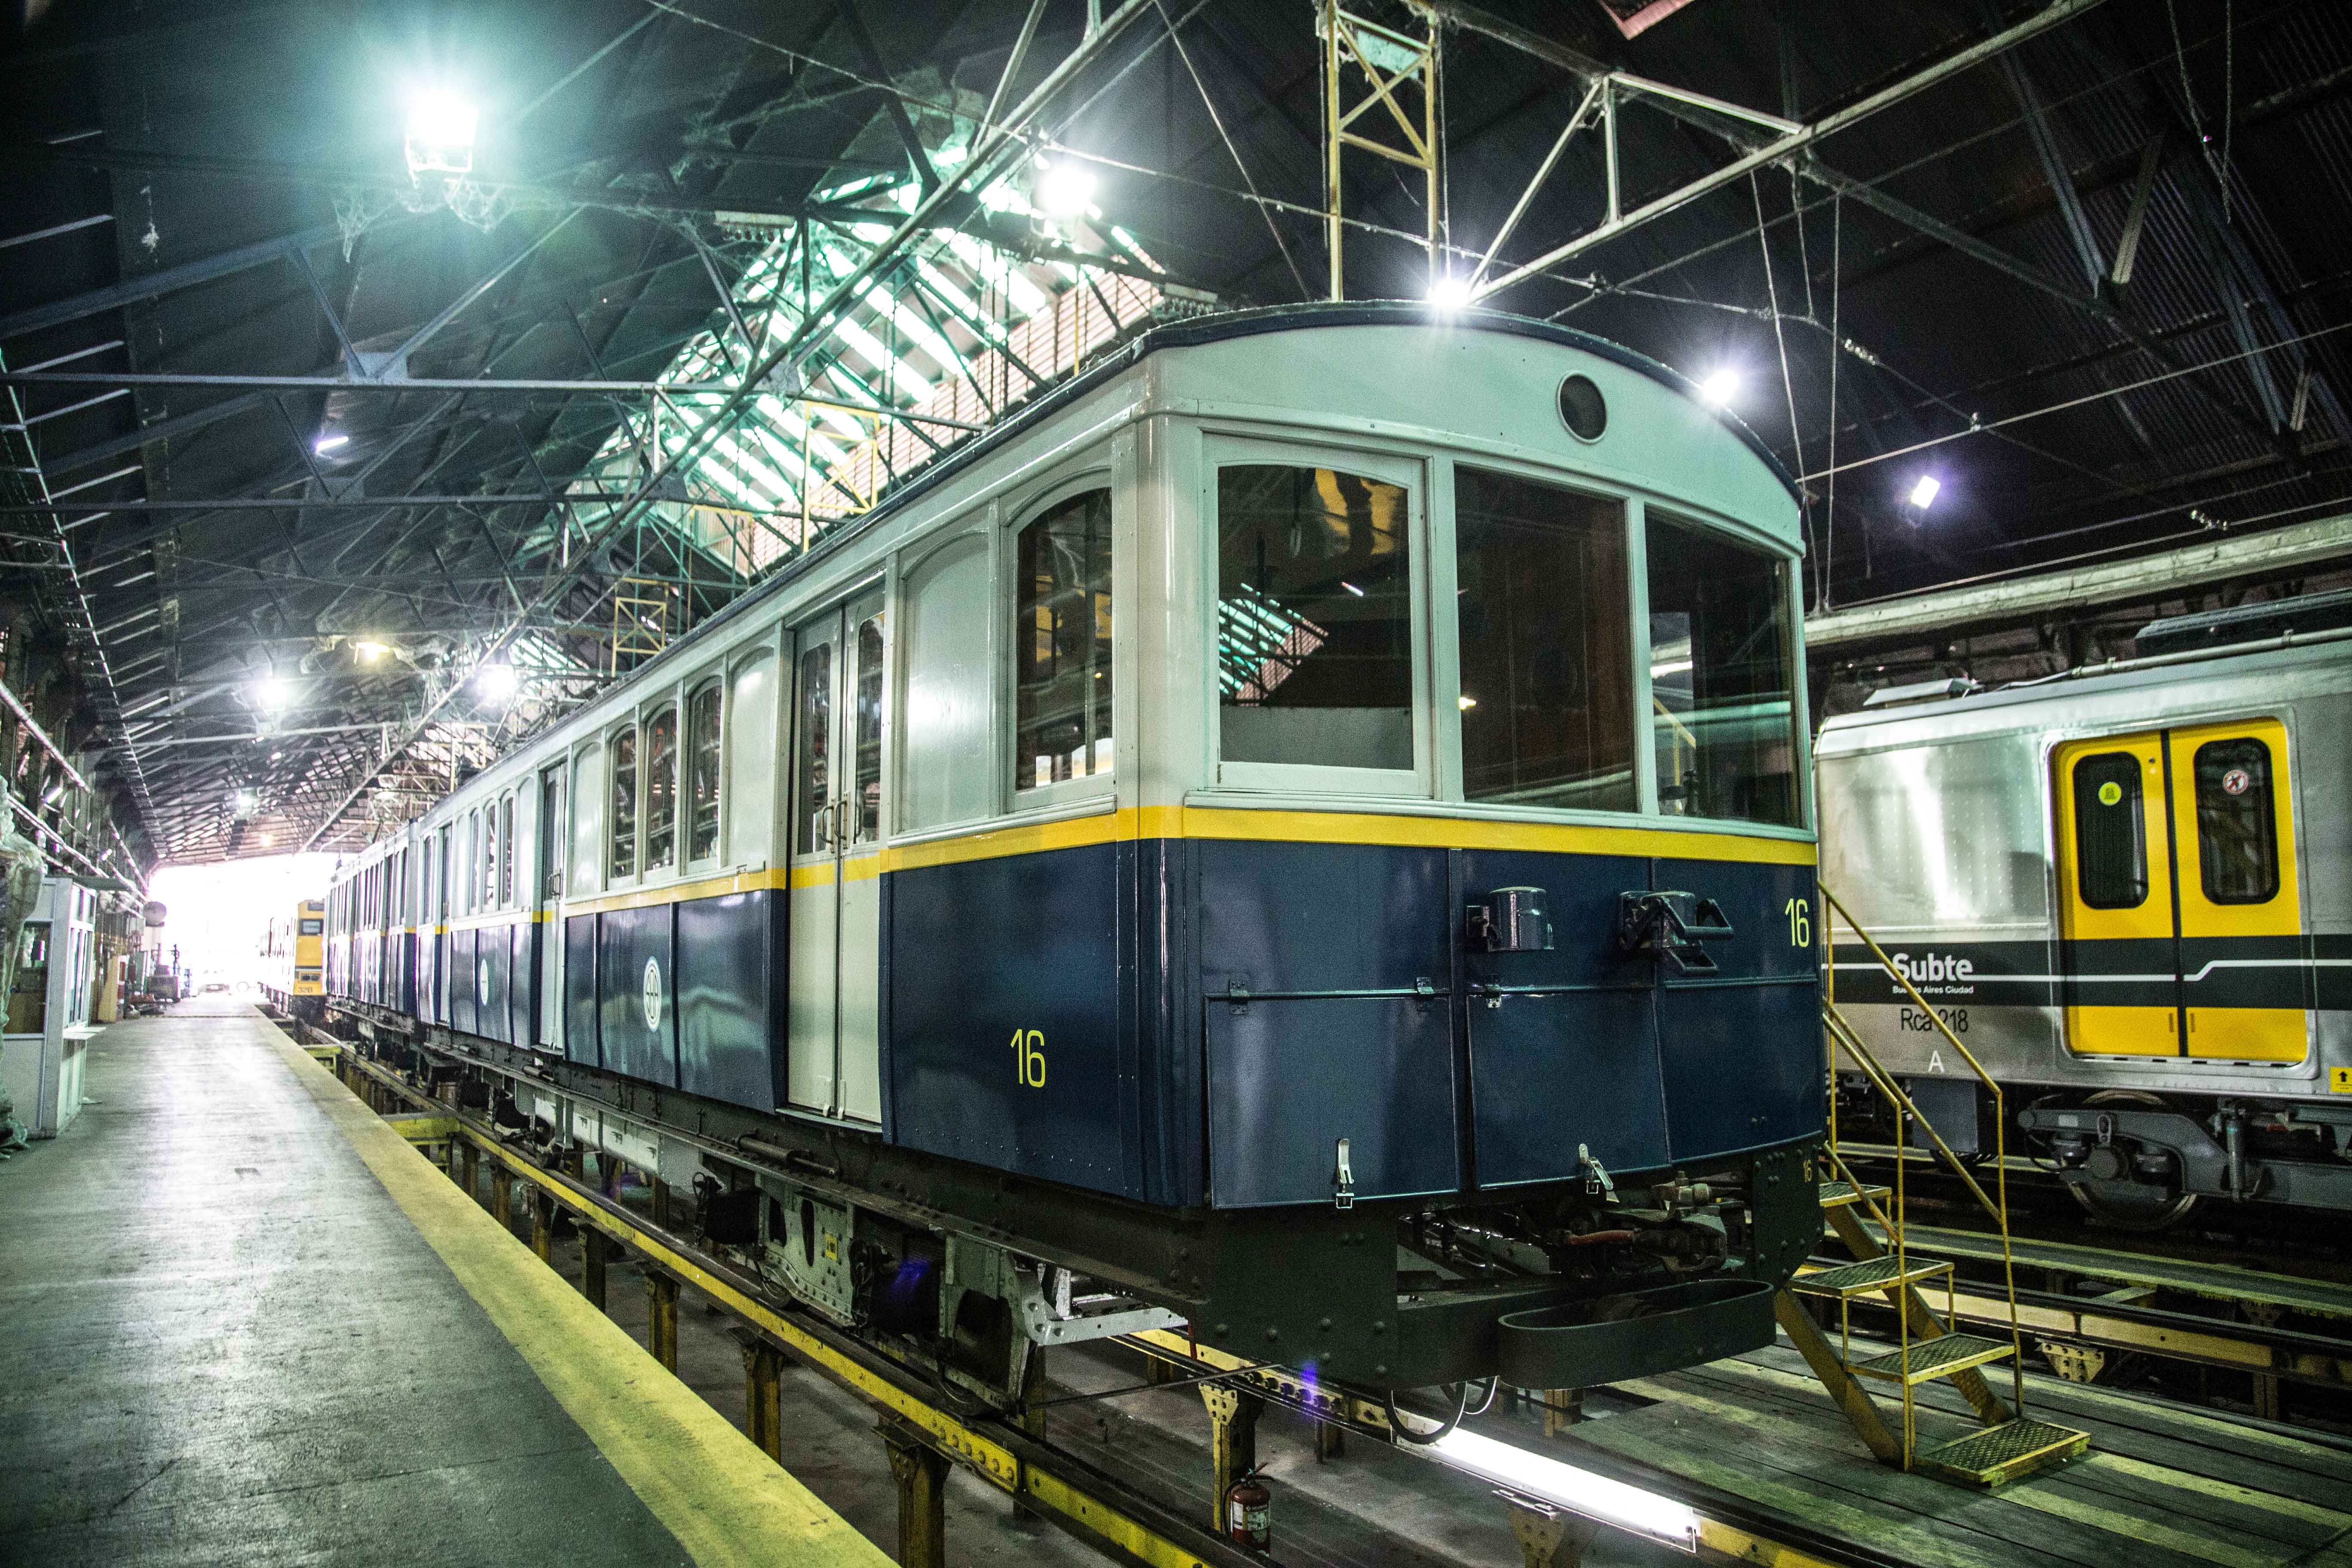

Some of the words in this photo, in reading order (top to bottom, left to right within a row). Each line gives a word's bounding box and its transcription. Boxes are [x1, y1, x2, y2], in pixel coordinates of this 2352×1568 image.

[1785, 898, 1809, 947] 16
[1893, 953, 1974, 981] Subte
[1945, 985, 1974, 993] Ciudad
[1901, 1008, 1932, 1031] Rca
[1938, 1009, 1969, 1032] 218
[1010, 1029, 1046, 1088] 16
[1928, 1050, 1945, 1073] A
